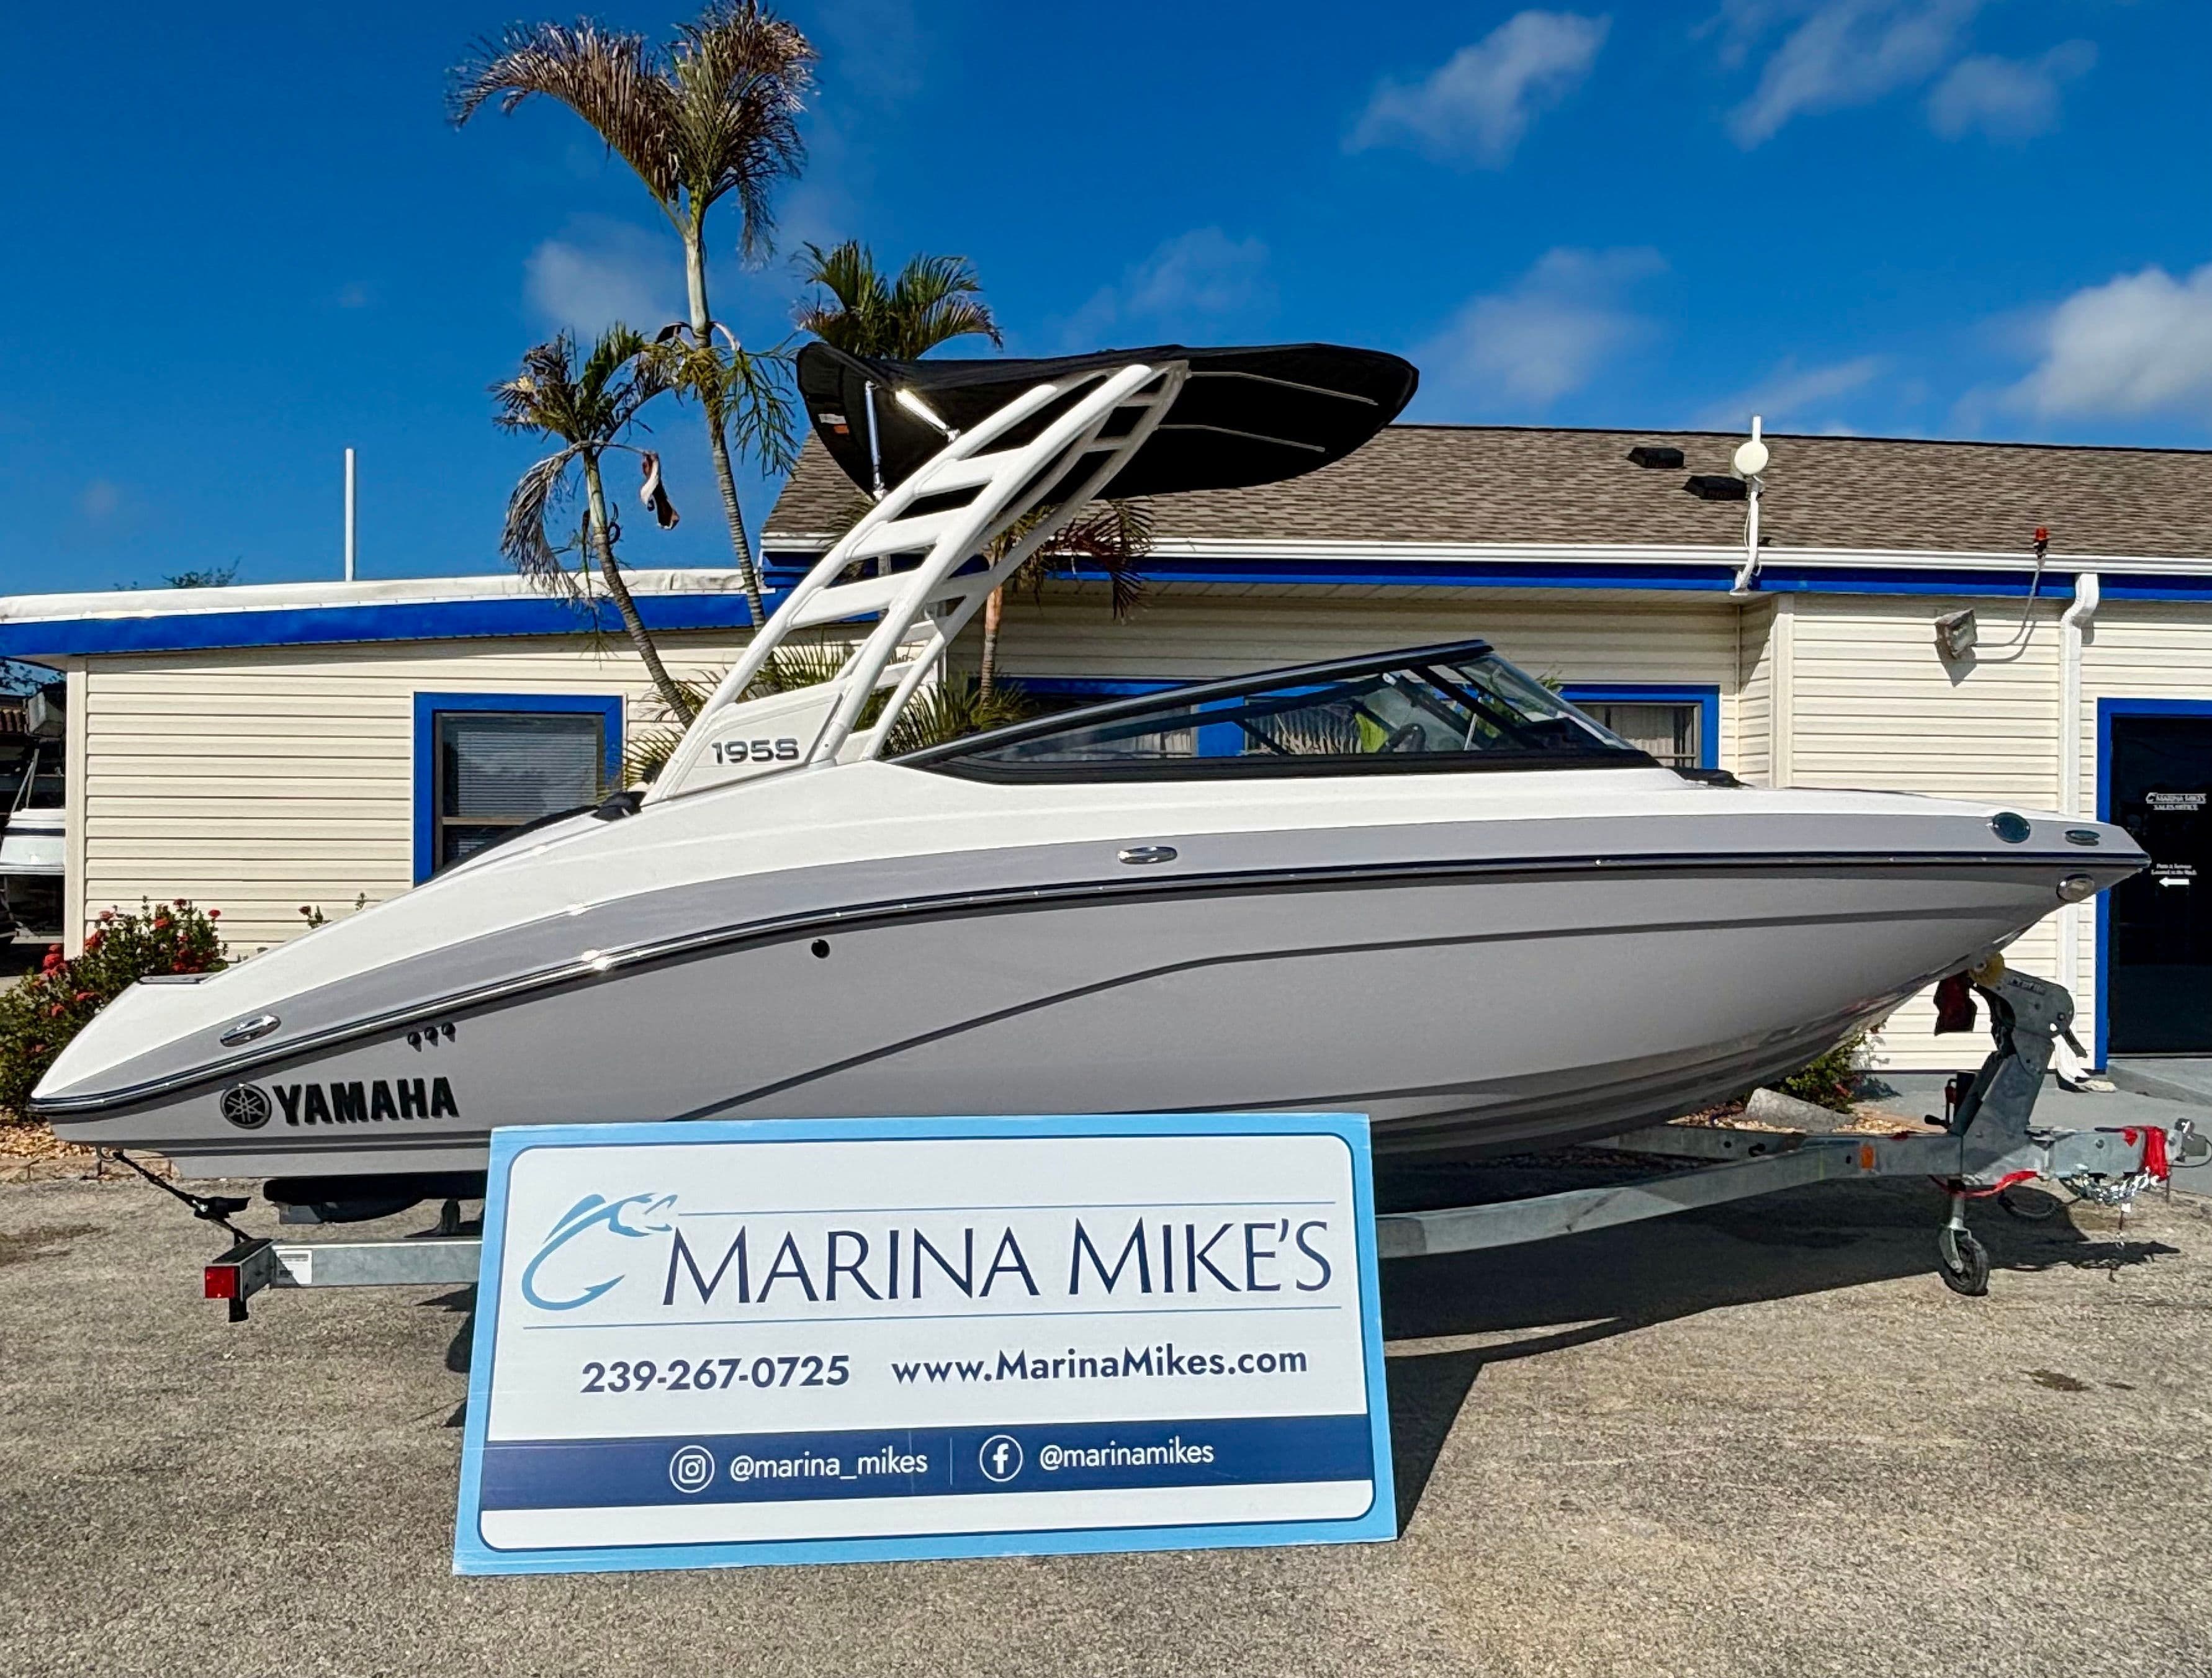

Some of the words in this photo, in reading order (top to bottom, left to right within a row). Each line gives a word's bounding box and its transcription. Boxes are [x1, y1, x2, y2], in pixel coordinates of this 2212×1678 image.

[711, 738, 799, 764] 195S
[272, 1076, 460, 1127] YAMAHA
[662, 1225, 1041, 1306] MARINA
[1068, 1217, 1332, 1295] MIKE'S
[580, 1355, 850, 1393] 239-267-0725
[891, 1343, 1307, 1384] www.MarinaMikes.com
[730, 1445, 928, 1482] @marina_mikes
[1040, 1435, 1215, 1471] @marinamikes
